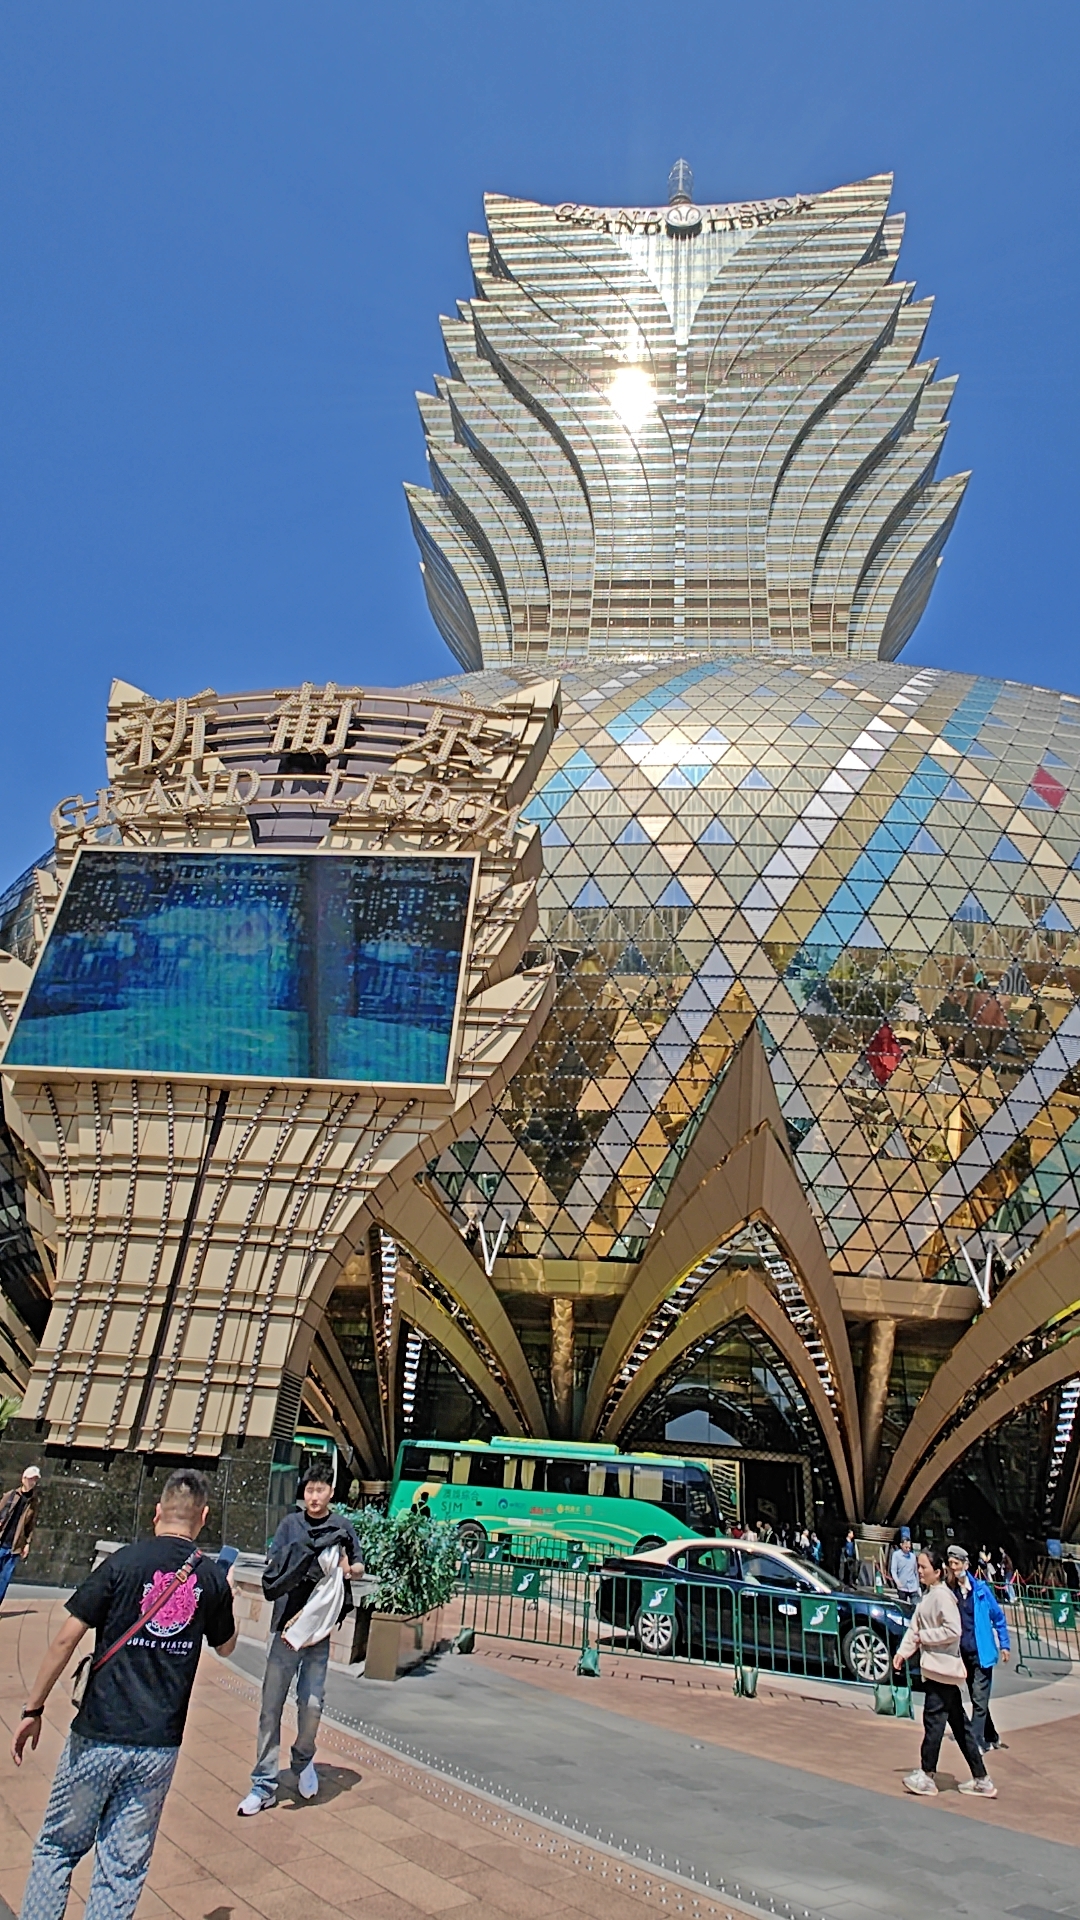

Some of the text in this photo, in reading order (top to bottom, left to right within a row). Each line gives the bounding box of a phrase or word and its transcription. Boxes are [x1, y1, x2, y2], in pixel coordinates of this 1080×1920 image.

[554, 194, 816, 230] GRAND LISBOA
[115, 682, 511, 768] 新葡京
[51, 768, 521, 848] GRAND LISBOA
[441, 1501, 463, 1513] SJM
